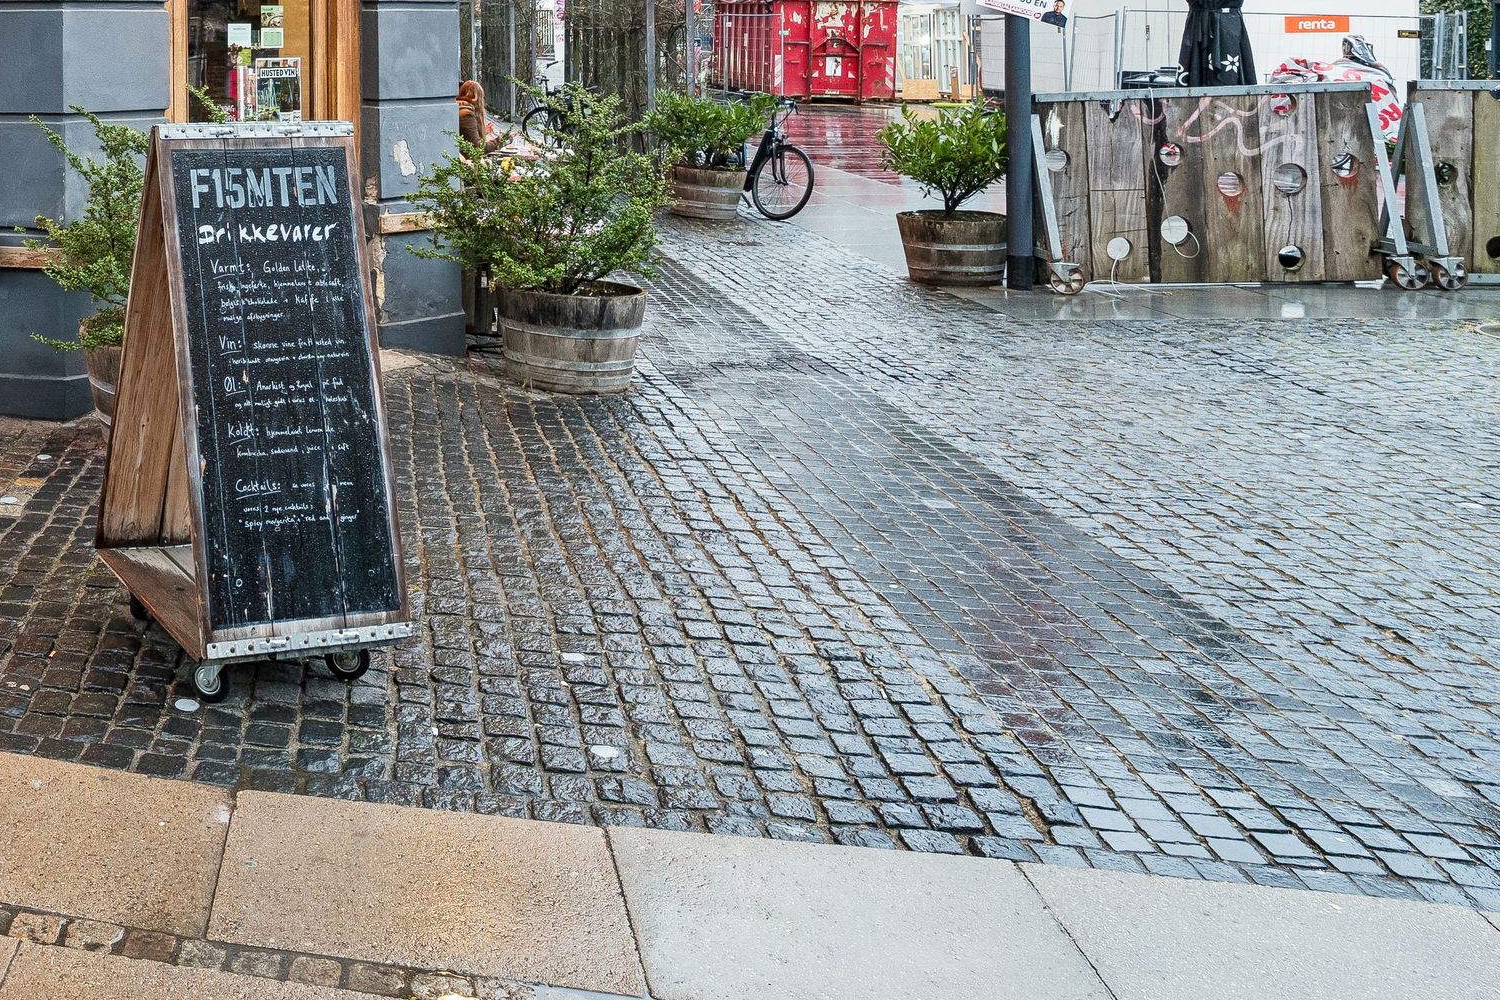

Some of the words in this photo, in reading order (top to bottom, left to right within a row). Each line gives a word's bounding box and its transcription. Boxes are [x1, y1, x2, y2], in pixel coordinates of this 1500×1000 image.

[1298, 19, 1335, 30] renta
[261, 68, 283, 77] HUSTED
[283, 68, 296, 76] VIN
[190, 165, 338, 210] F15MTEN
[199, 222, 338, 245] Drikkevarer
[263, 260, 290, 273] Golden
[218, 334, 242, 350] Vin:
[235, 478, 281, 493] Cocktails:
